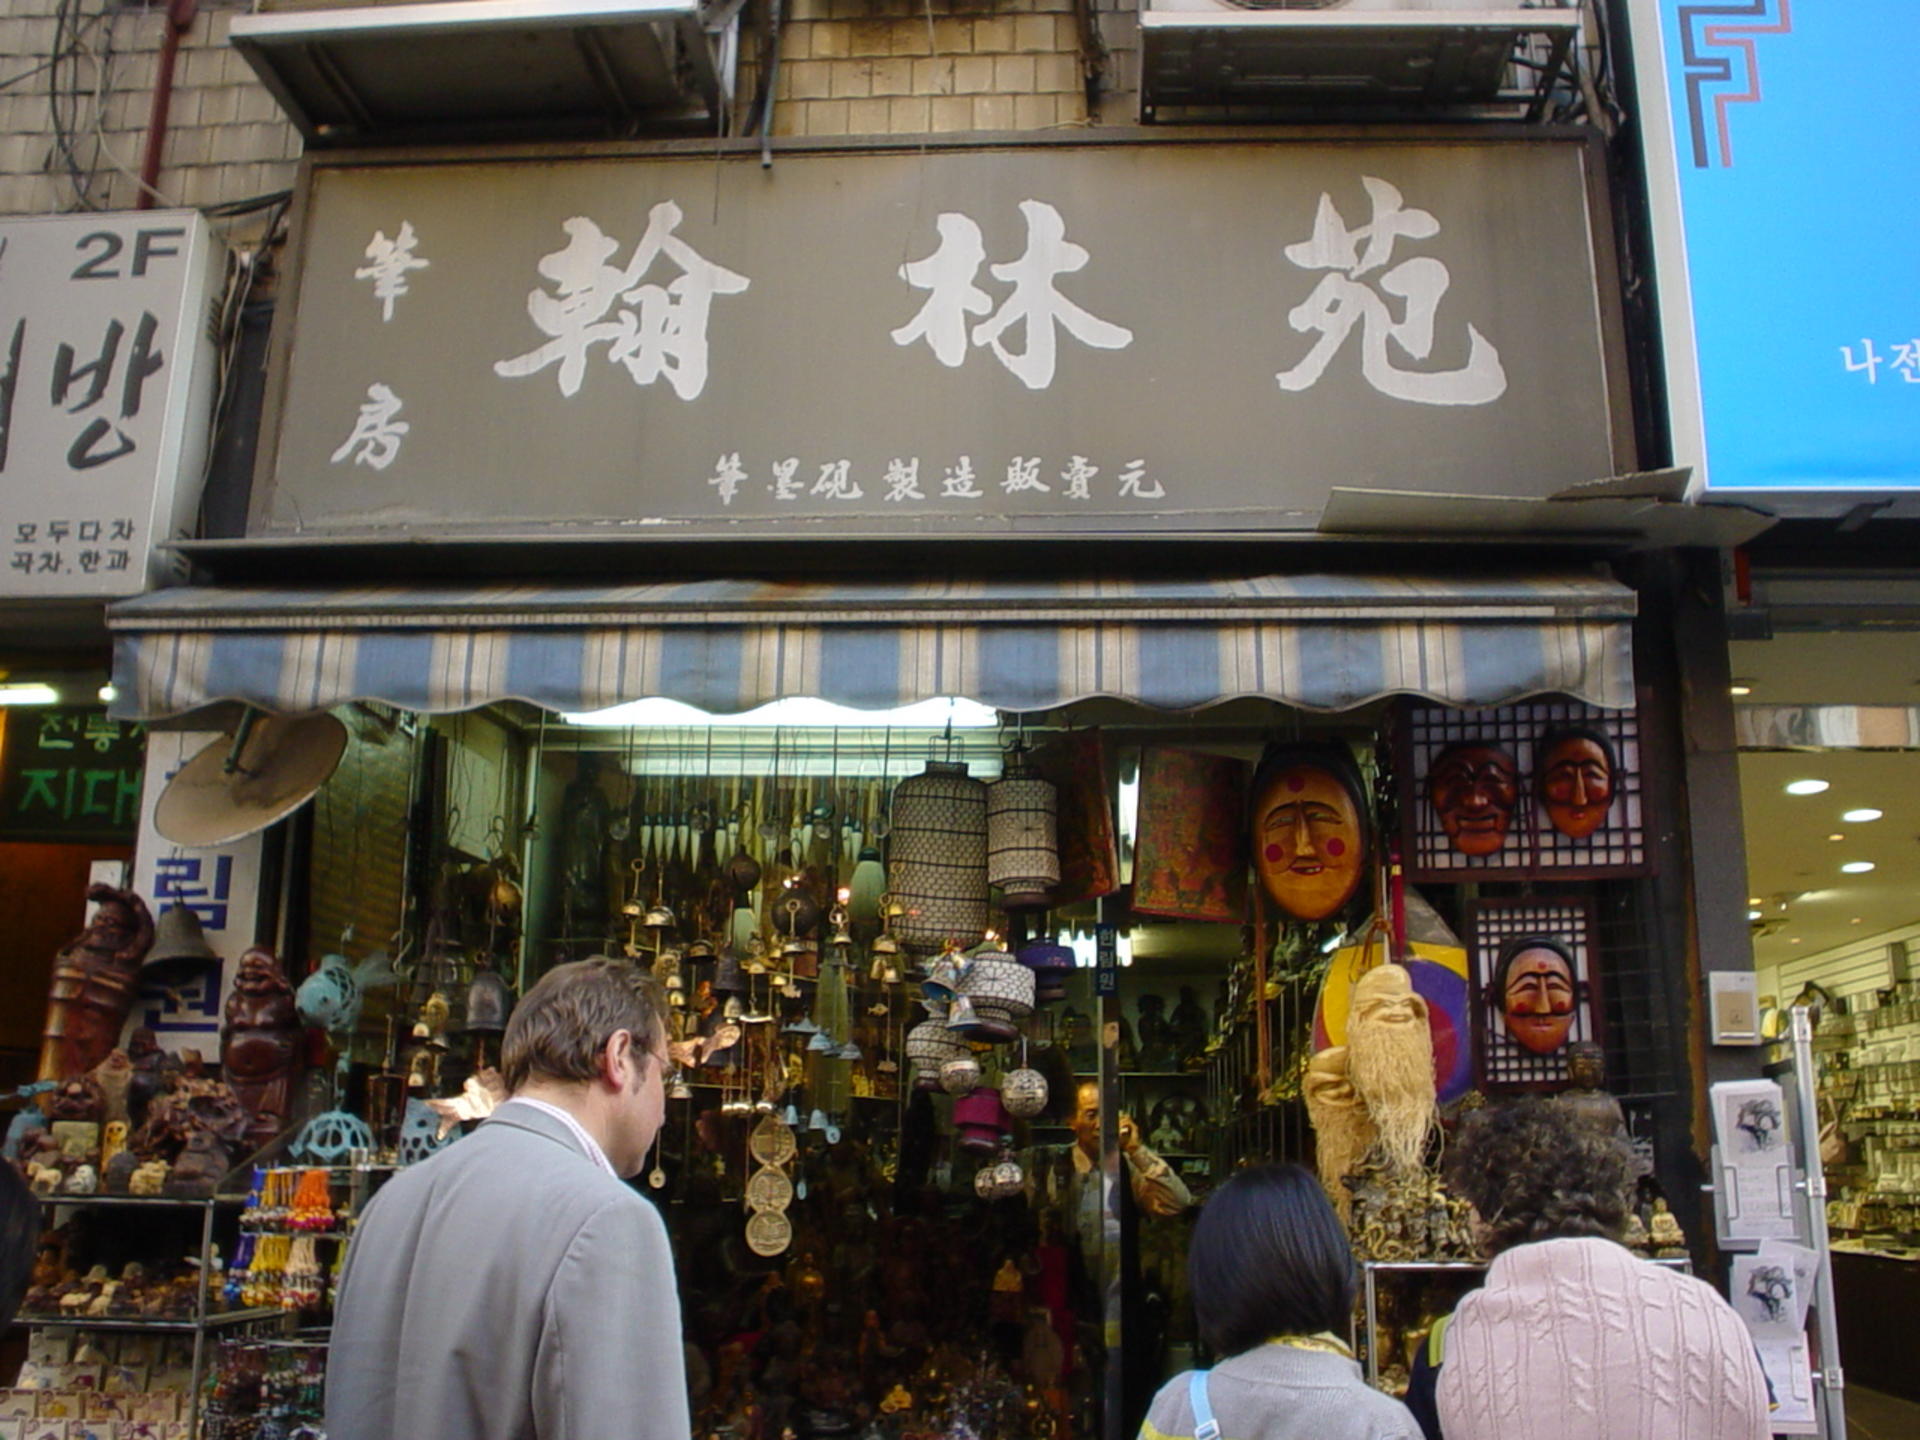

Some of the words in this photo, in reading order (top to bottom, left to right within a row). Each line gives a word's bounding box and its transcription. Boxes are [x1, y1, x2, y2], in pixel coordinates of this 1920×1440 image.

[70, 228, 186, 279] 2F
[494, 183, 1507, 407] 翰林苑
[0, 310, 163, 473] 방
[38, 713, 147, 752] 전통
[144, 760, 233, 1032] 림원
